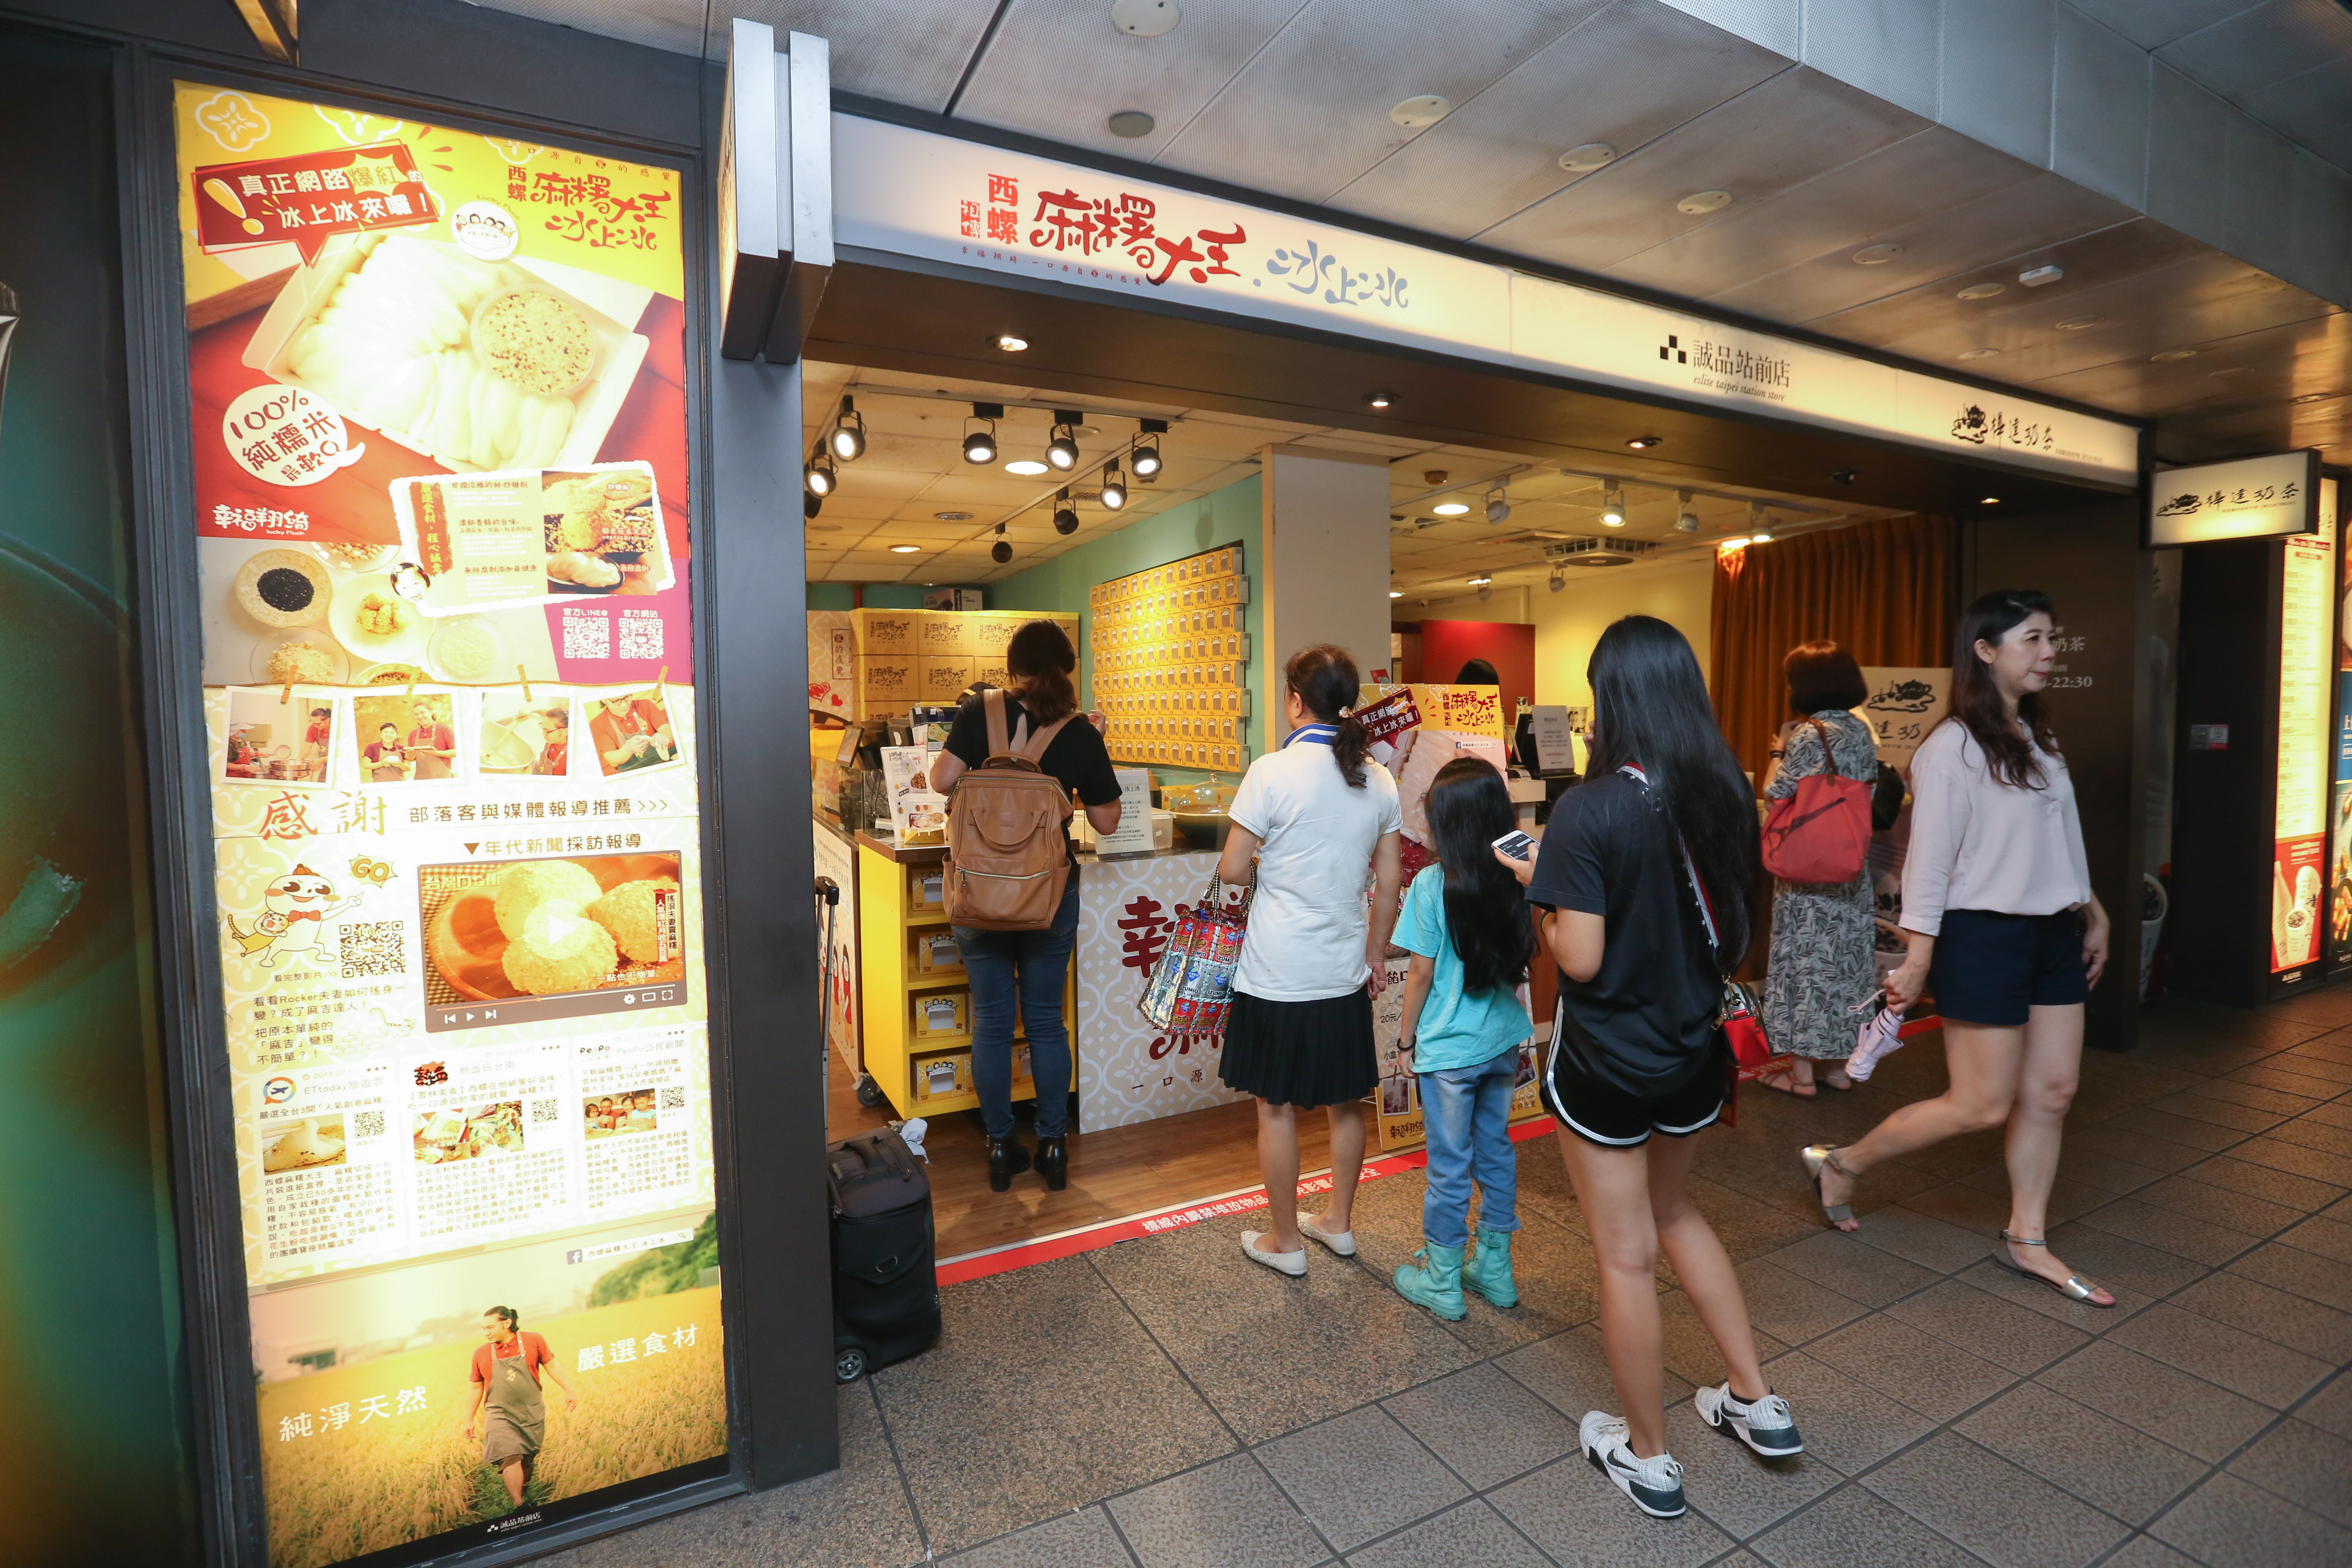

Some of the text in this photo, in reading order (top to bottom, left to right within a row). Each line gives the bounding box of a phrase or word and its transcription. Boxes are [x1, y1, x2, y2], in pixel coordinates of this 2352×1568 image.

[238, 166, 423, 197] 真正網路爆紅的
[508, 164, 527, 202] 西螺
[477, 193, 520, 221] Lucky Much
[961, 199, 980, 238] 祖傳
[987, 172, 1018, 245] 西螺
[544, 210, 657, 251] 冰上冰
[1266, 239, 1410, 309] 冰上冰
[1693, 339, 1791, 388] 誠品站前店
[1693, 373, 1786, 402] eslite taipei station store
[230, 390, 309, 439] 100%
[242, 411, 337, 471] 純糯米
[281, 440, 341, 482] 最軟Q
[2205, 481, 2299, 512] 樺達奶茶
[212, 503, 310, 532] 幸福翔綺
[464, 564, 538, 575] 無防腐劑添加最健康
[619, 564, 650, 572] 無防腐劑
[622, 609, 659, 619] 官方網站
[1442, 693, 1450, 710] 西螺
[1456, 709, 1495, 727] 冰上冰
[258, 790, 388, 841] 感謝
[409, 798, 632, 824] 部落客與媒體報導推薦
[484, 832, 642, 856] 年代新聞採訪報導
[352, 858, 390, 882] GO
[657, 898, 668, 963] 人氣爆紅月收五百萬
[273, 971, 323, 982] 看完整影片
[596, 969, 657, 982] 一點也不簡單
[253, 985, 406, 1008] 看看Rocker夫妻如何搖身一
[1180, 986, 1199, 994] IZUMIO
[255, 1020, 333, 1038] 把原本單純的
[260, 1034, 334, 1050] 「麻吉」變得
[616, 1039, 684, 1055] PeoPo公民新聞
[304, 1077, 383, 1095] ETtoday旅遊雲
[313, 1068, 357, 1079] 2018.07.11
[1141, 1194, 1269, 1232] 標線內嚴禁堆放物品
[577, 1323, 698, 1373] 嚴選食材
[279, 1385, 428, 1442] 純淨天然
